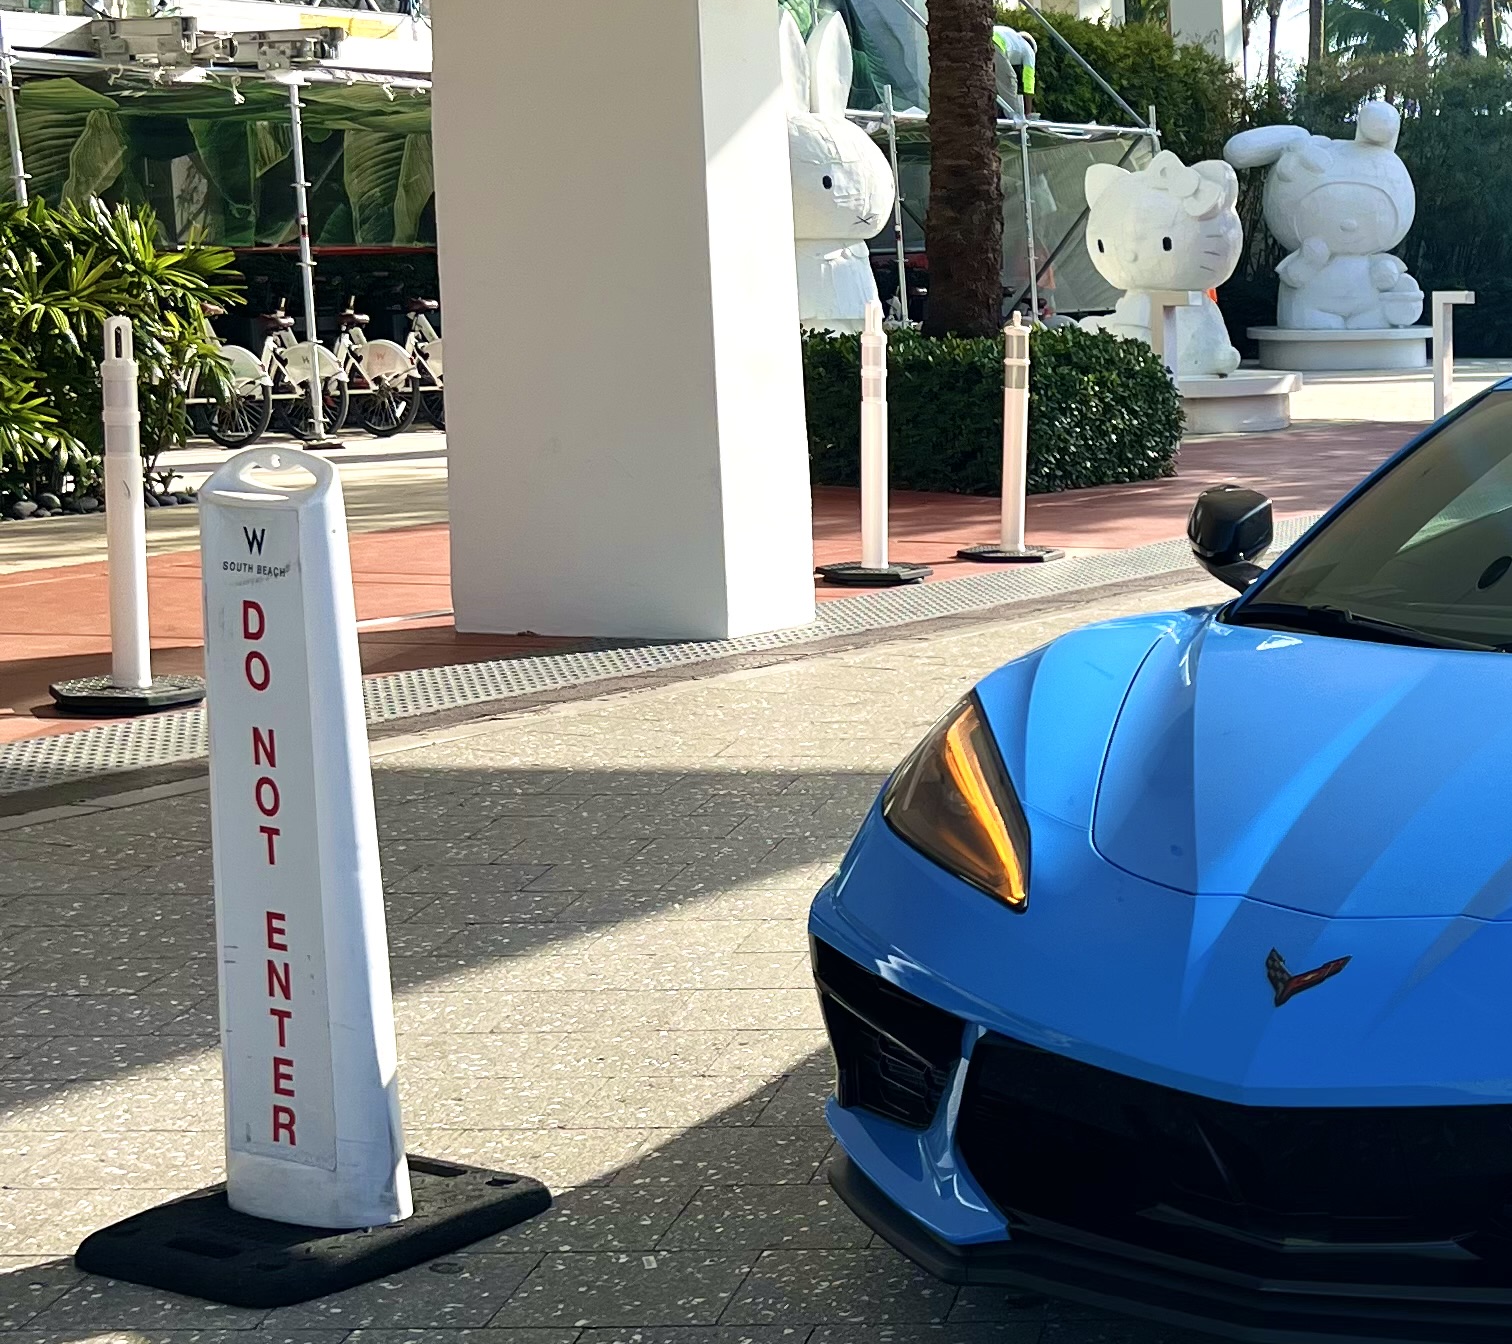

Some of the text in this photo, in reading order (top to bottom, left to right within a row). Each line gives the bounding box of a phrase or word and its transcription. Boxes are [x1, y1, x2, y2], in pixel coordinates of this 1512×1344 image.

[242, 526, 266, 556] W
[222, 560, 286, 578] SOUTH BEACH
[242, 599, 296, 1145] DO NOT ENTER
